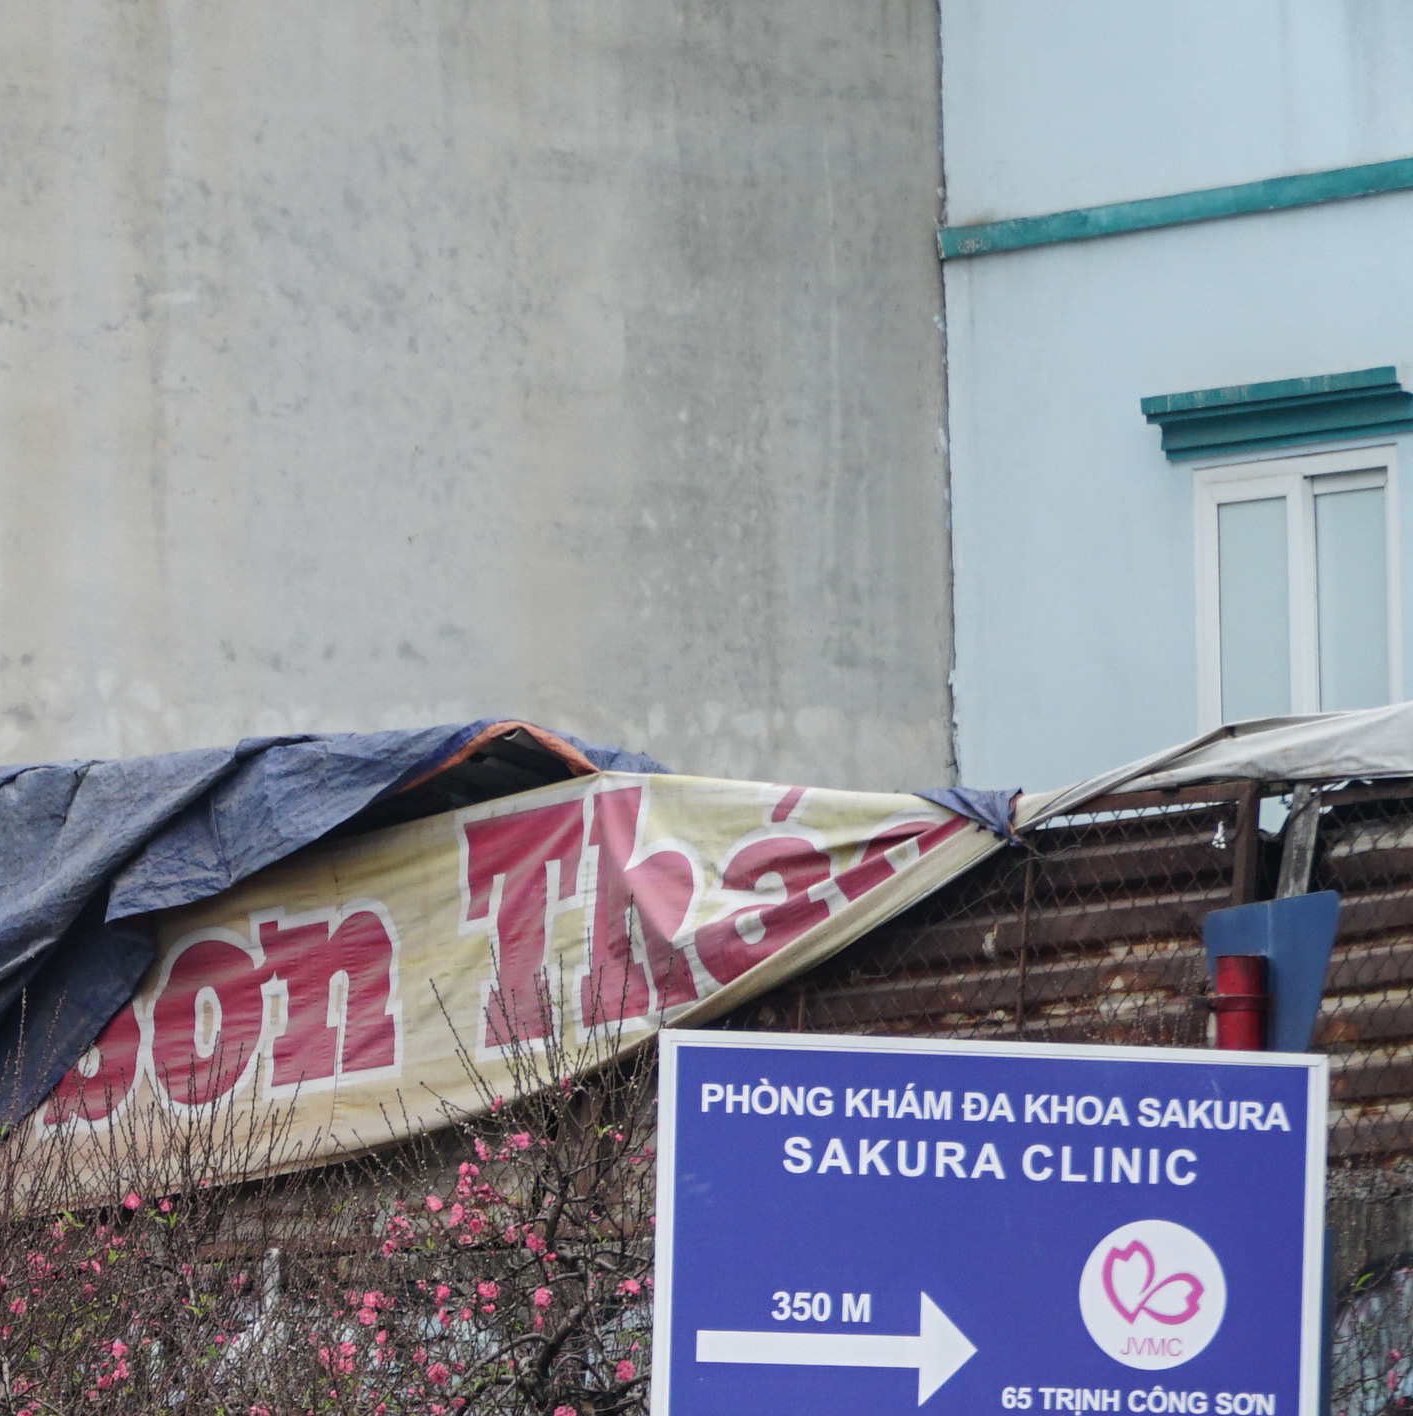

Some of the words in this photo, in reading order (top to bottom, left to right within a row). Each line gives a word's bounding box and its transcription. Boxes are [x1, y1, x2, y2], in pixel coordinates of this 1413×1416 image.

[701, 1078, 835, 1117] PHÒNG
[844, 1082, 952, 1121] KHÁM
[961, 1091, 1016, 1123] ĐA
[1024, 1093, 1131, 1127] KHOA
[1137, 1097, 1291, 1132] SAKURA
[782, 1136, 1007, 1180] SAKURA
[1021, 1143, 1198, 1186] CLINIC
[771, 1290, 832, 1322] 350
[841, 1292, 872, 1323] M
[1119, 1336, 1184, 1357] JVMC
[1001, 1386, 1033, 1410] 65
[1038, 1387, 1121, 1416] TRỊNH
[1127, 1384, 1209, 1415] CÔNG
[1214, 1391, 1277, 1416] SƠN
